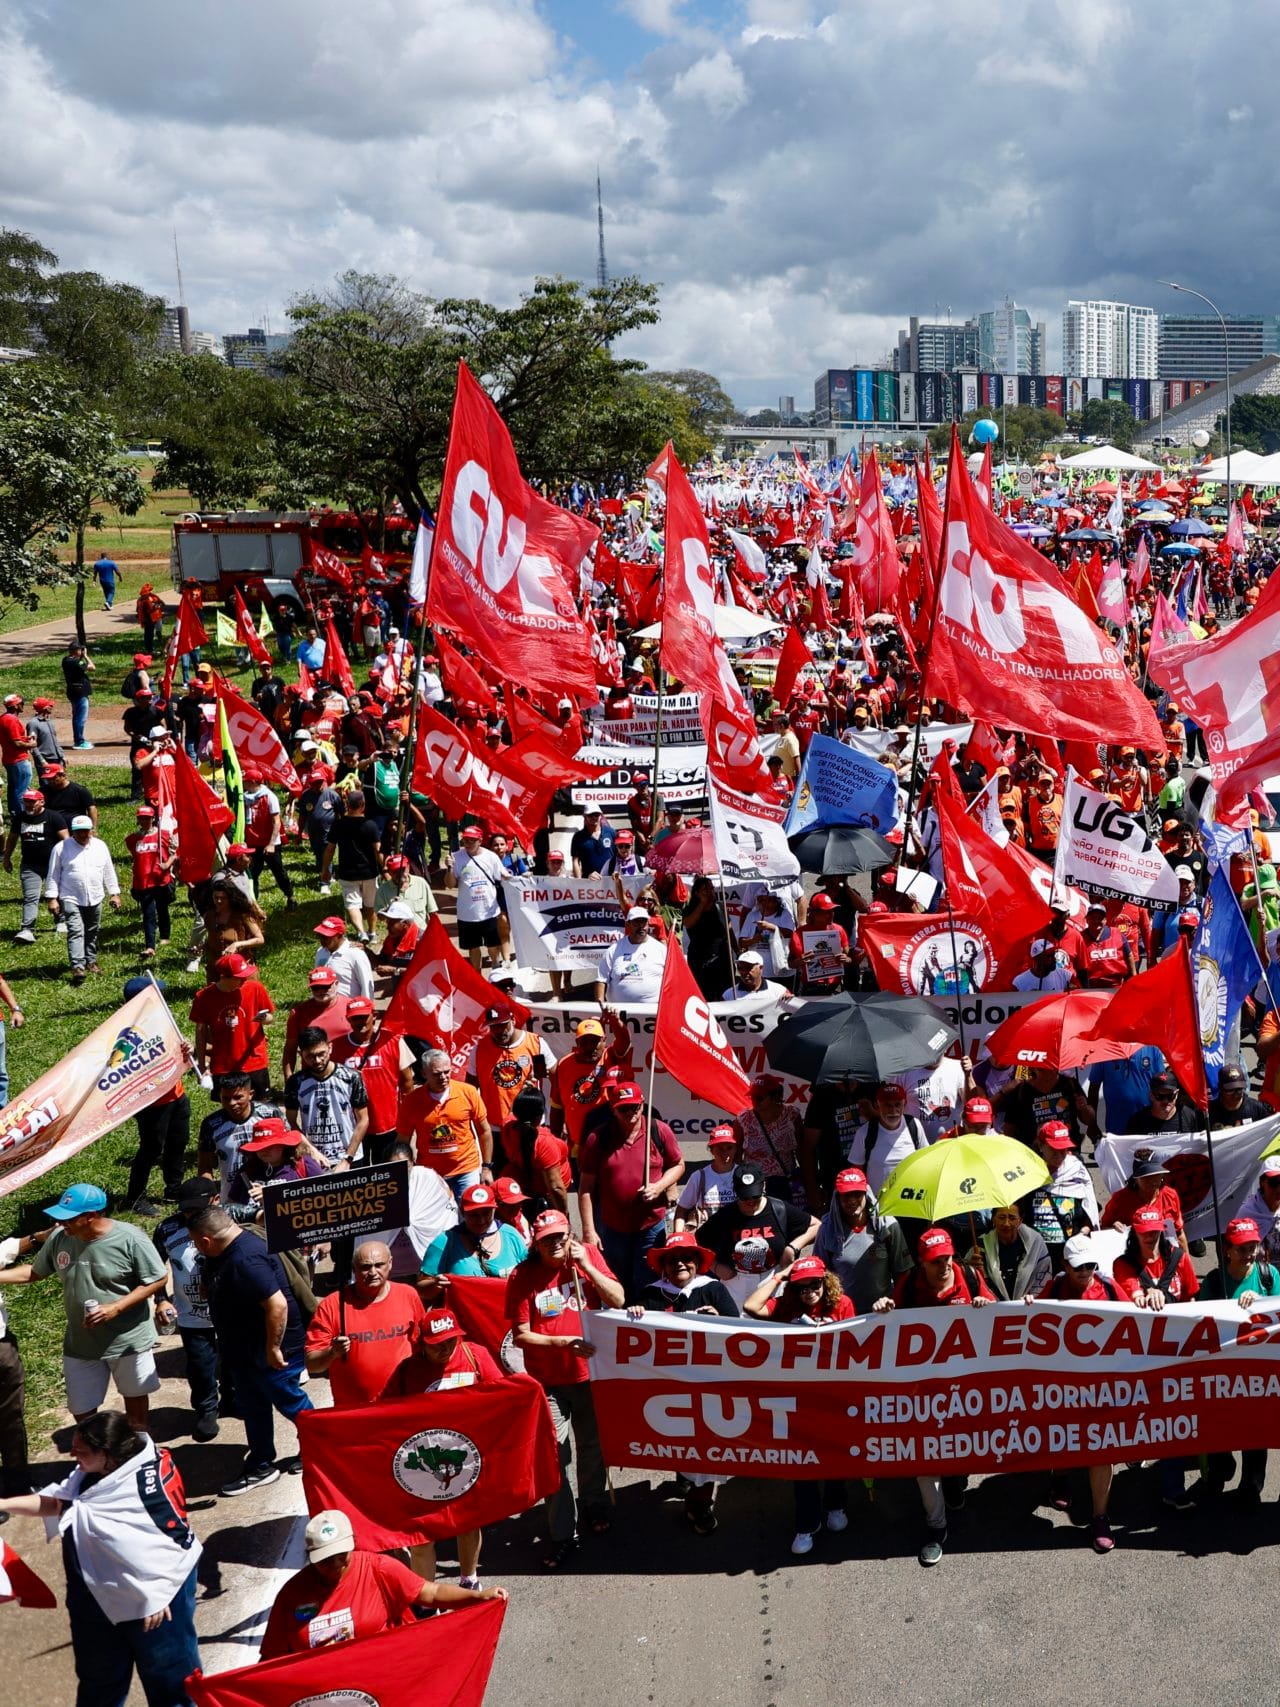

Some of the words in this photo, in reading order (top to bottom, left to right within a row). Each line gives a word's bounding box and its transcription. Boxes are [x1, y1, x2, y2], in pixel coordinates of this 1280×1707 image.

[452, 459, 557, 616] CUT
[661, 698, 677, 708] FIM
[680, 697, 692, 707] DA
[630, 721, 648, 732] PARA
[671, 718, 685, 729] NÃO
[670, 733, 683, 743] FIM
[825, 778, 855, 795] CARGAS
[827, 763, 878, 789] TRANSPORTES
[585, 789, 633, 801] DIGINIDA
[1097, 847, 1133, 862] GERAL
[1138, 859, 1162, 870] DOS
[522, 889, 549, 902] FIM
[552, 889, 574, 901] DA
[1106, 890, 1127, 899] UGT
[1128, 895, 1148, 907] UGT
[1150, 901, 1170, 911] UGT
[556, 912, 581, 924] sem
[900, 944, 913, 995] MOVIMENTO
[911, 925, 936, 944] TERRA
[139, 1034, 162, 1052] 2026
[97, 1042, 168, 1091] CONCLAT
[283, 1175, 368, 1199] Fortalecimento
[370, 1172, 391, 1182] das
[276, 1181, 399, 1217] NEGOCIAÇÕES
[292, 1200, 386, 1229] COLETIVAS
[304, 1232, 344, 1244] SOROCABA
[351, 1225, 378, 1234] REGIÃO
[615, 1326, 770, 1368] PELO
[781, 1325, 885, 1370] FIM
[895, 1318, 978, 1367] DA
[989, 1312, 1222, 1358] ESCALA
[864, 1384, 983, 1429] REDUÇÃO
[990, 1386, 1025, 1414] DA
[1032, 1379, 1150, 1411] JORNADA
[1162, 1377, 1195, 1401] DE
[643, 1393, 798, 1440] CUT
[403, 1430, 457, 1449] TRABALHADORES
[865, 1436, 916, 1462] SEM
[924, 1420, 1042, 1463] REDUÇÃO
[1049, 1424, 1081, 1452] DE
[1088, 1413, 1198, 1451] SALÁRIO!
[629, 1442, 702, 1460] SANTA
[706, 1446, 820, 1465] CATARINA
[144, 1464, 158, 1495] Regi
